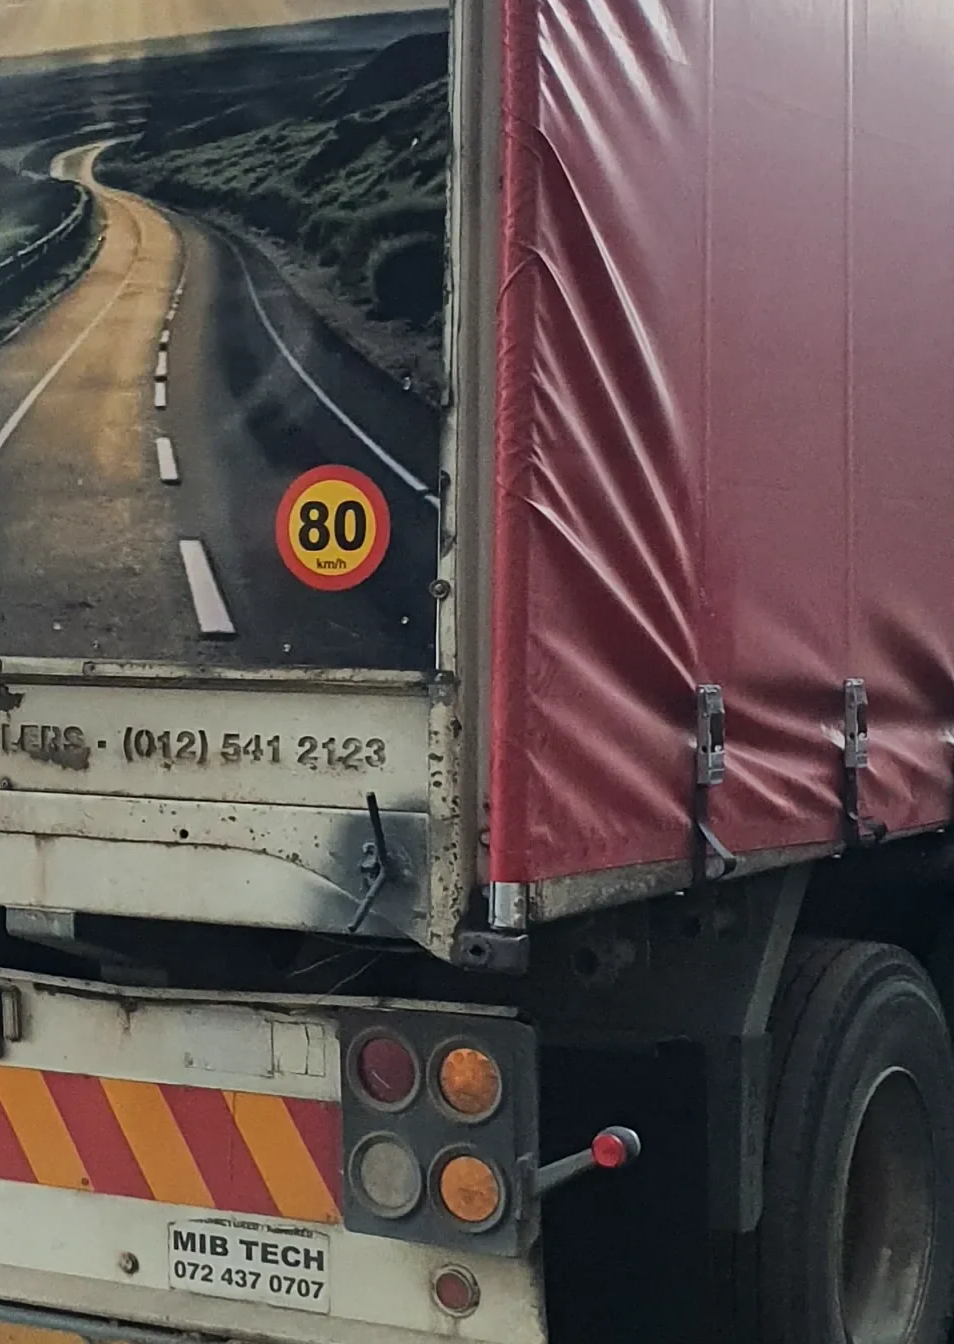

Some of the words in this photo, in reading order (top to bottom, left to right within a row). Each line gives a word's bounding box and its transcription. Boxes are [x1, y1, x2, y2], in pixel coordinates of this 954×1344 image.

[298, 500, 366, 551] 80
[316, 558, 346, 569] km/h
[124, 727, 208, 763] (012)
[221, 732, 280, 763] 541
[298, 735, 386, 768] 2123
[173, 1230, 229, 1256] MIB
[239, 1239, 324, 1271] TECH
[174, 1260, 213, 1282] 072
[221, 1268, 261, 1290] 437
[270, 1275, 324, 1299] 0707
